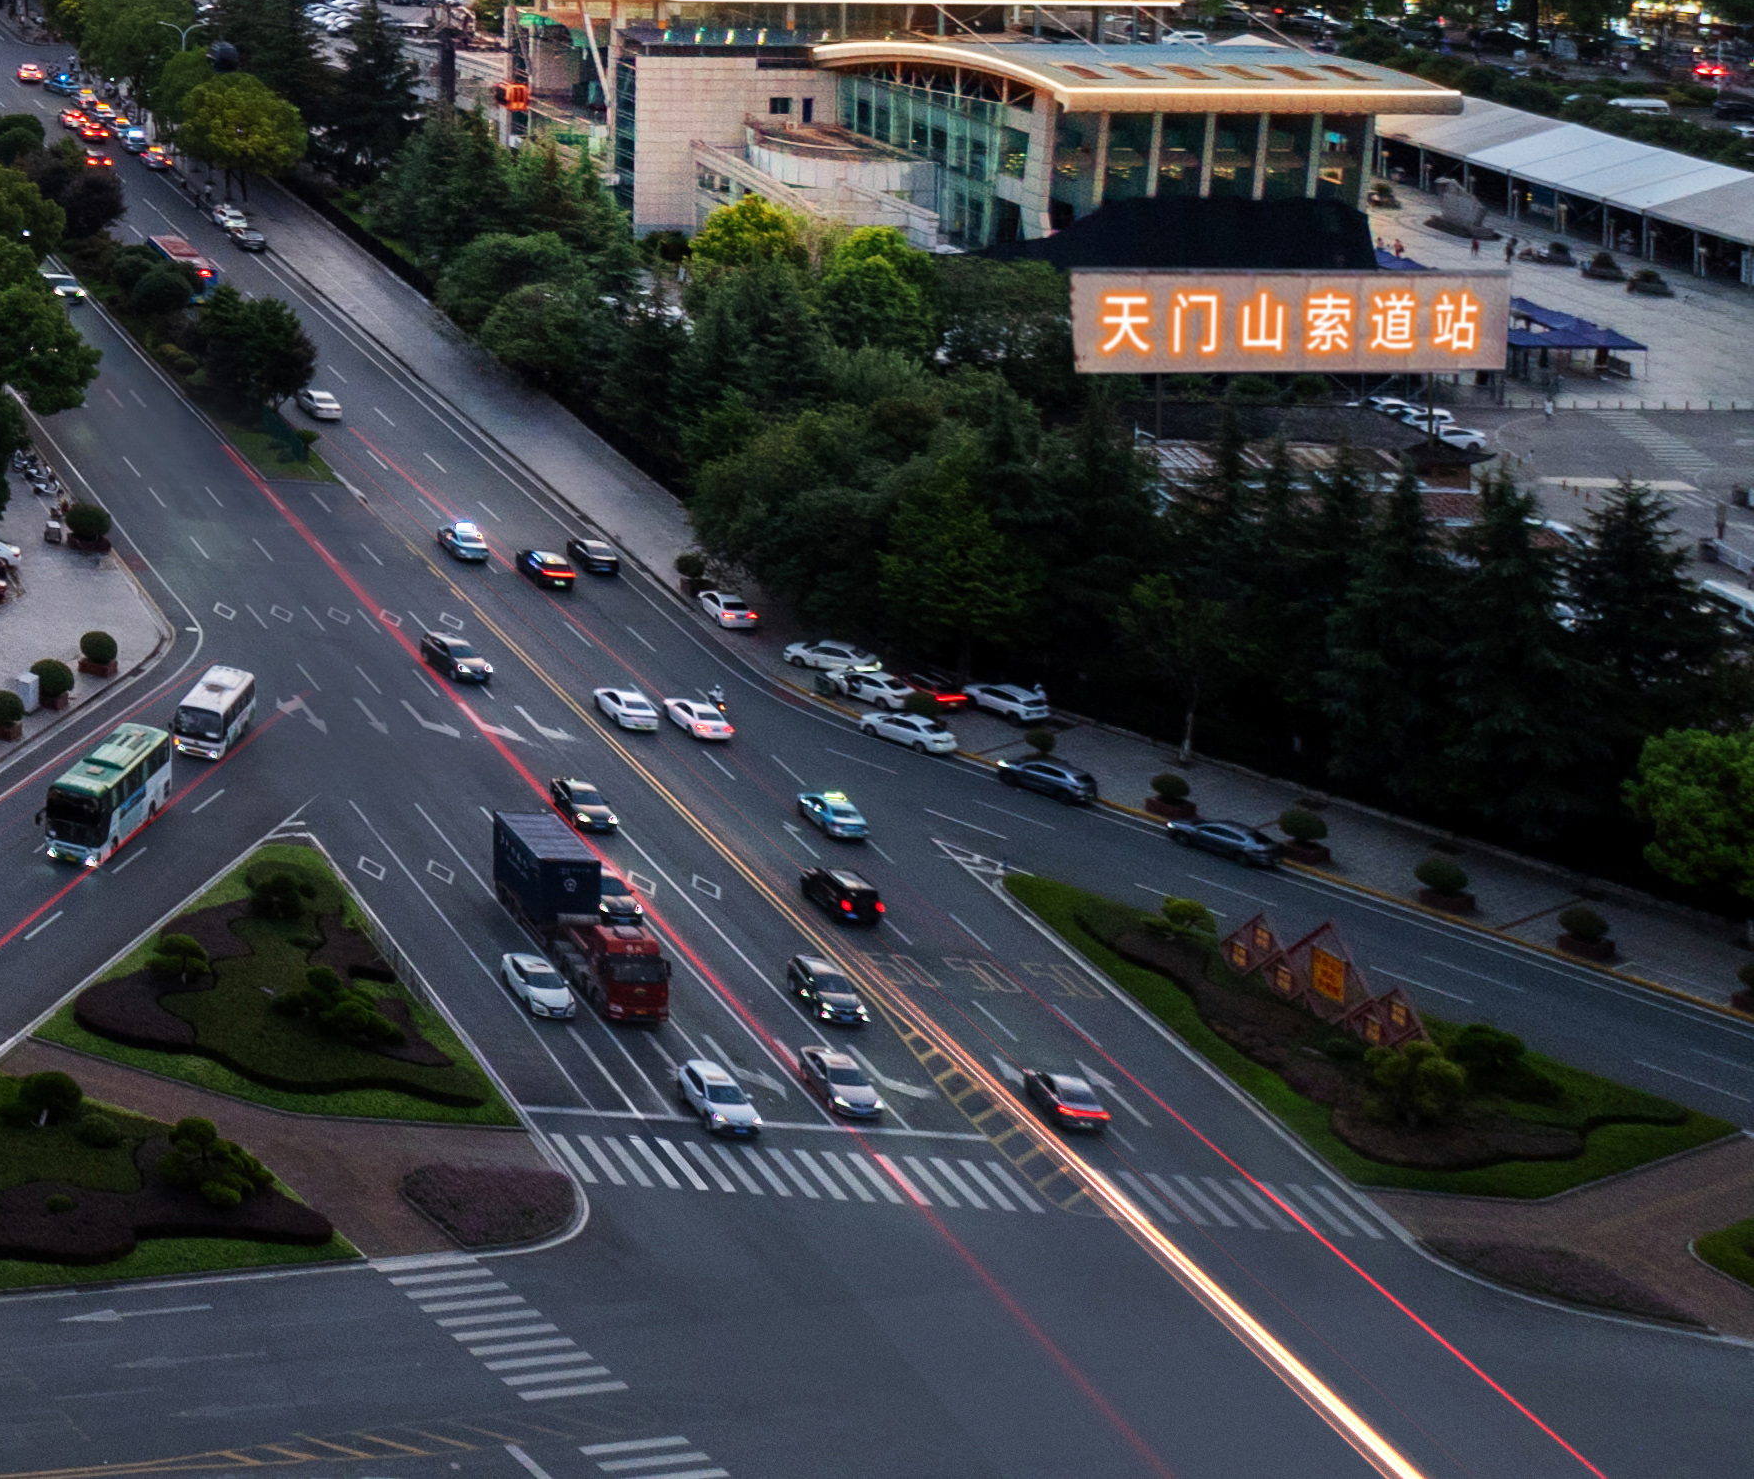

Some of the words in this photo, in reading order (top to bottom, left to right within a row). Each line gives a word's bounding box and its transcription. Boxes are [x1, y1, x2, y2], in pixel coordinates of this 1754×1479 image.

[1102, 292, 1479, 353] 天门山索道站
